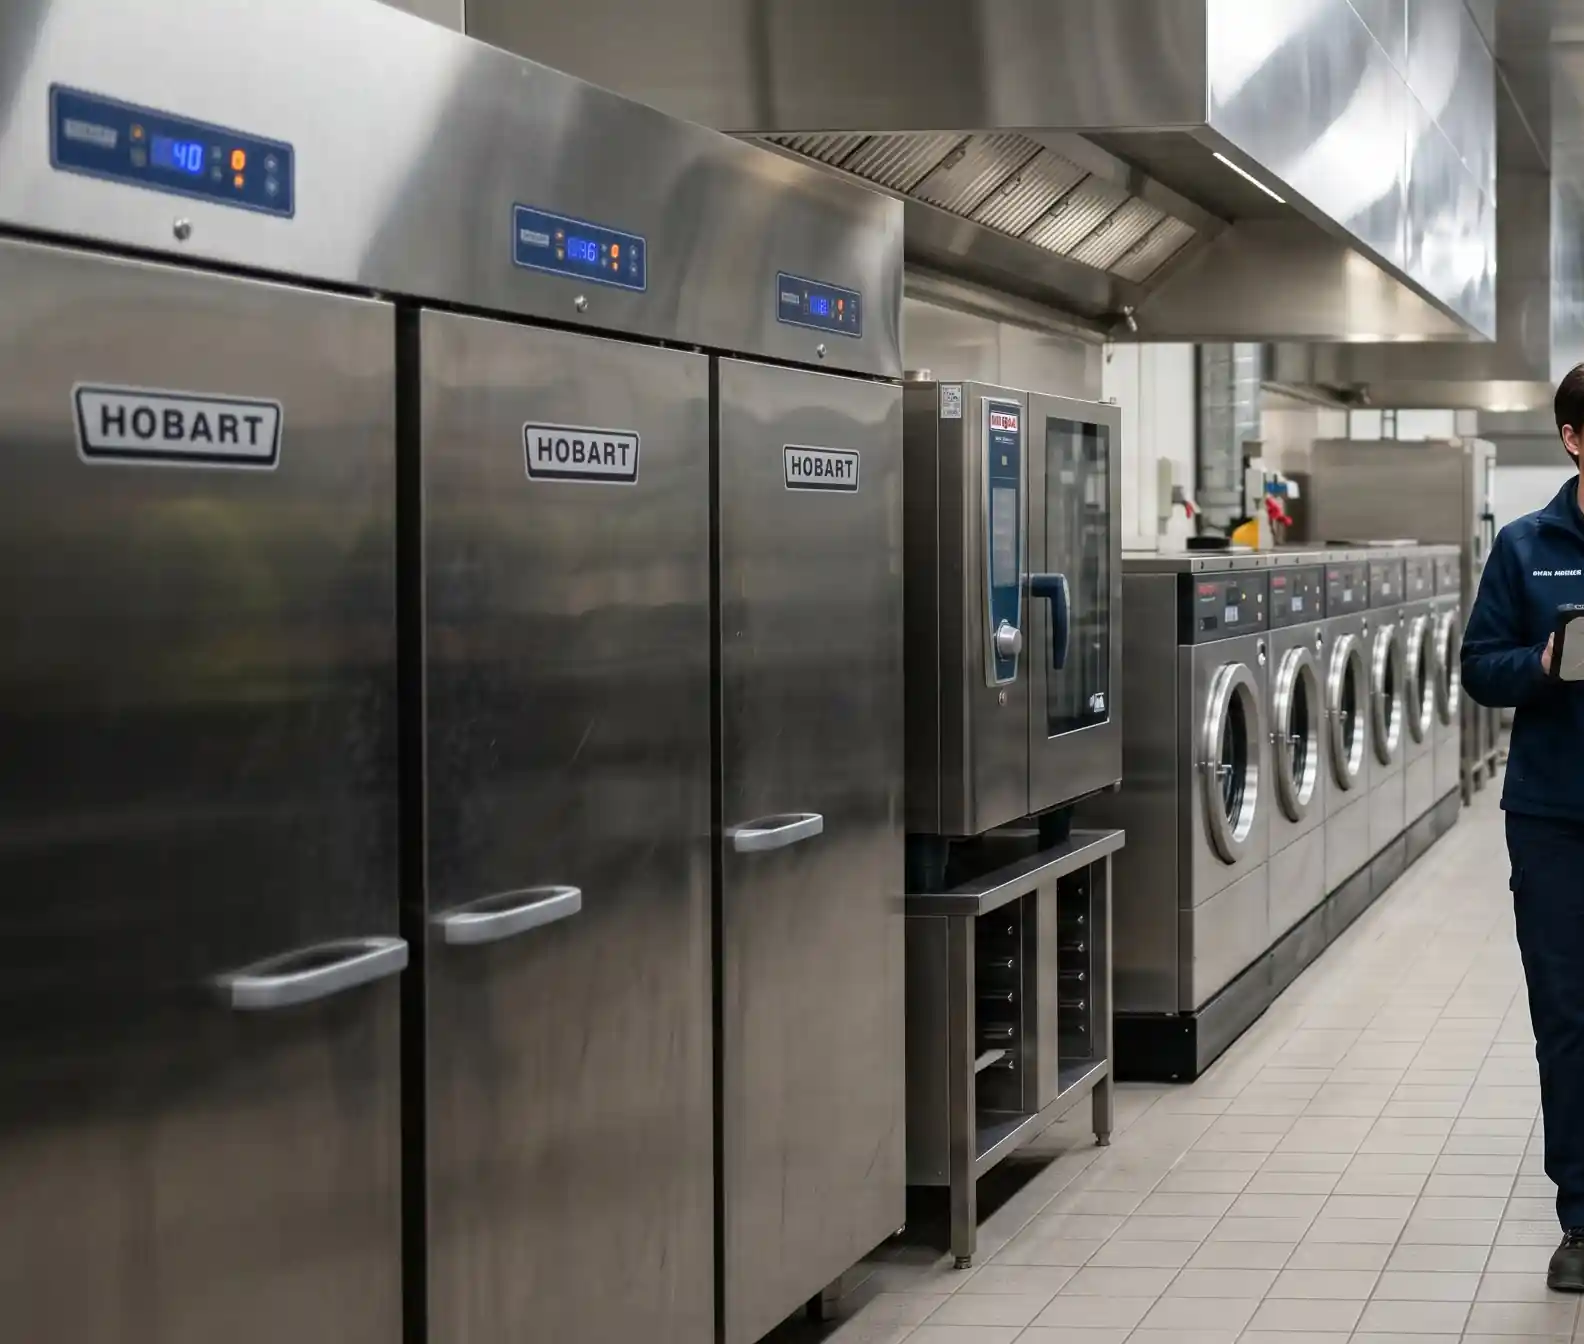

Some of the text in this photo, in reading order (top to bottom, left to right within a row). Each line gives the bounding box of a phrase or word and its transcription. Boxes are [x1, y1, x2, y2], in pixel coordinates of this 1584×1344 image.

[173, 143, 203, 172] 40
[101, 405, 263, 445] HOBART
[538, 437, 630, 466] HOBART
[791, 456, 853, 478] HOBART
